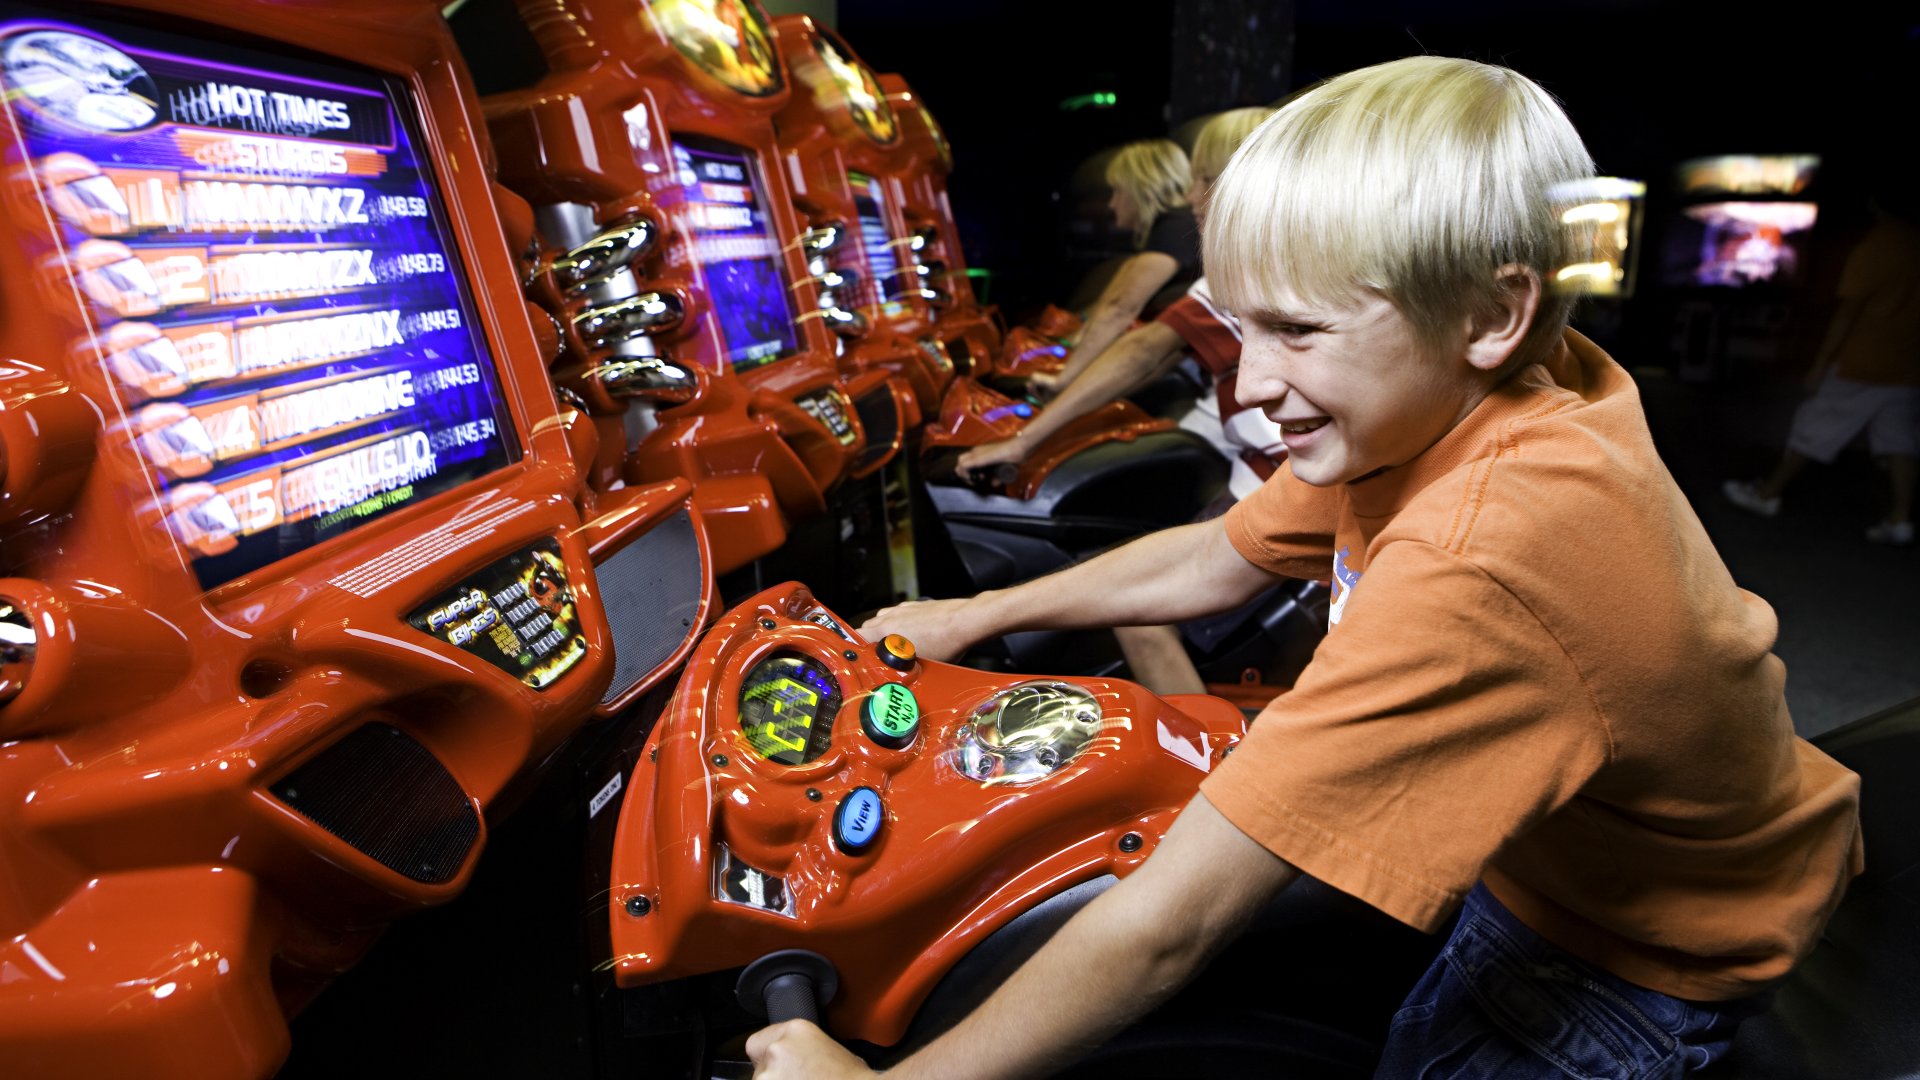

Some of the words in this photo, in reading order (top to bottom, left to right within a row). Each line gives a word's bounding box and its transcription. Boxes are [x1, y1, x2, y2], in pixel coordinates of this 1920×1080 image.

[207, 82, 267, 124] HOT
[271, 91, 350, 129] TIMES
[238, 139, 348, 174] STURGIS
[164, 255, 206, 299] 2
[198, 332, 232, 377] 3
[223, 405, 256, 450] 4
[249, 488, 277, 530] 5
[431, 589, 485, 629] SUPER
[450, 608, 497, 646] BIKES
[883, 685, 904, 731] START
